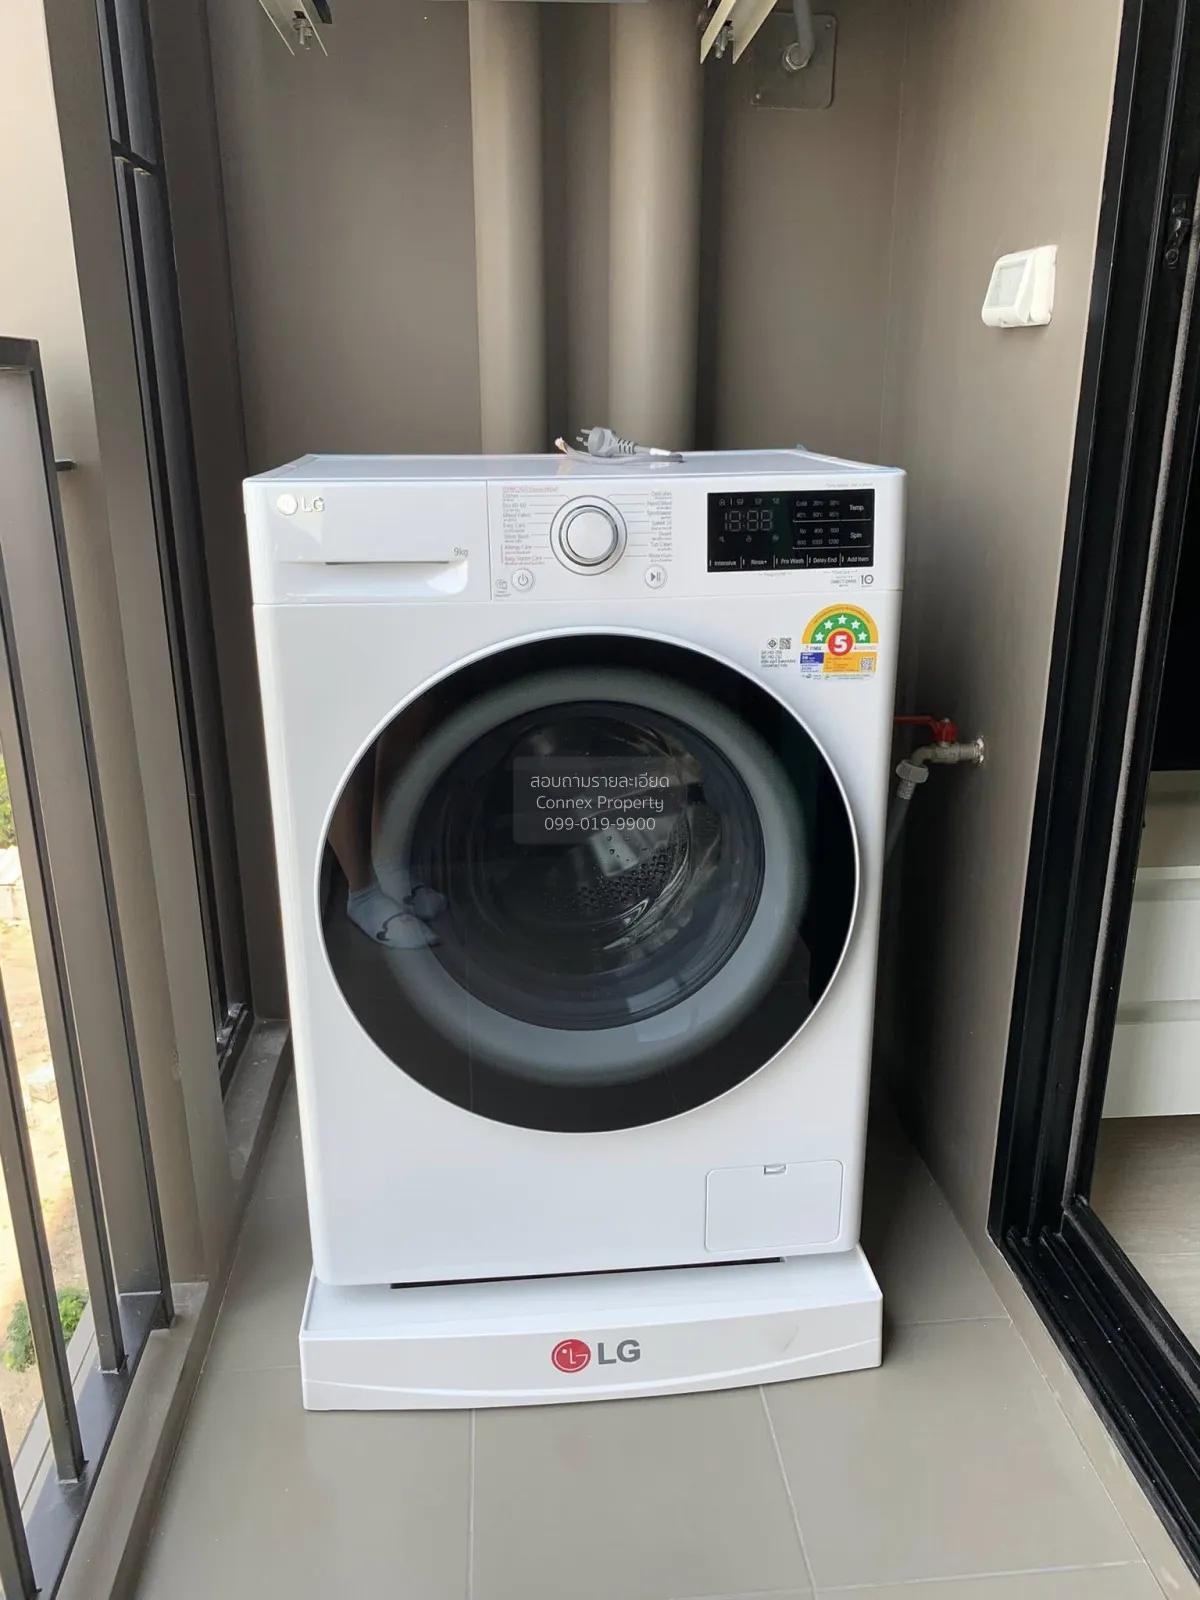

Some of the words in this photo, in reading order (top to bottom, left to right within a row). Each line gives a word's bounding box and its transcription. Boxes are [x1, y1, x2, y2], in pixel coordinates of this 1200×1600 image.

[301, 495, 325, 512] LG
[849, 504, 865, 512] Temp.
[850, 531, 863, 539] Spin
[453, 546, 469, 558] 9kg
[833, 634, 848, 653] 5
[597, 1339, 641, 1365] LG
